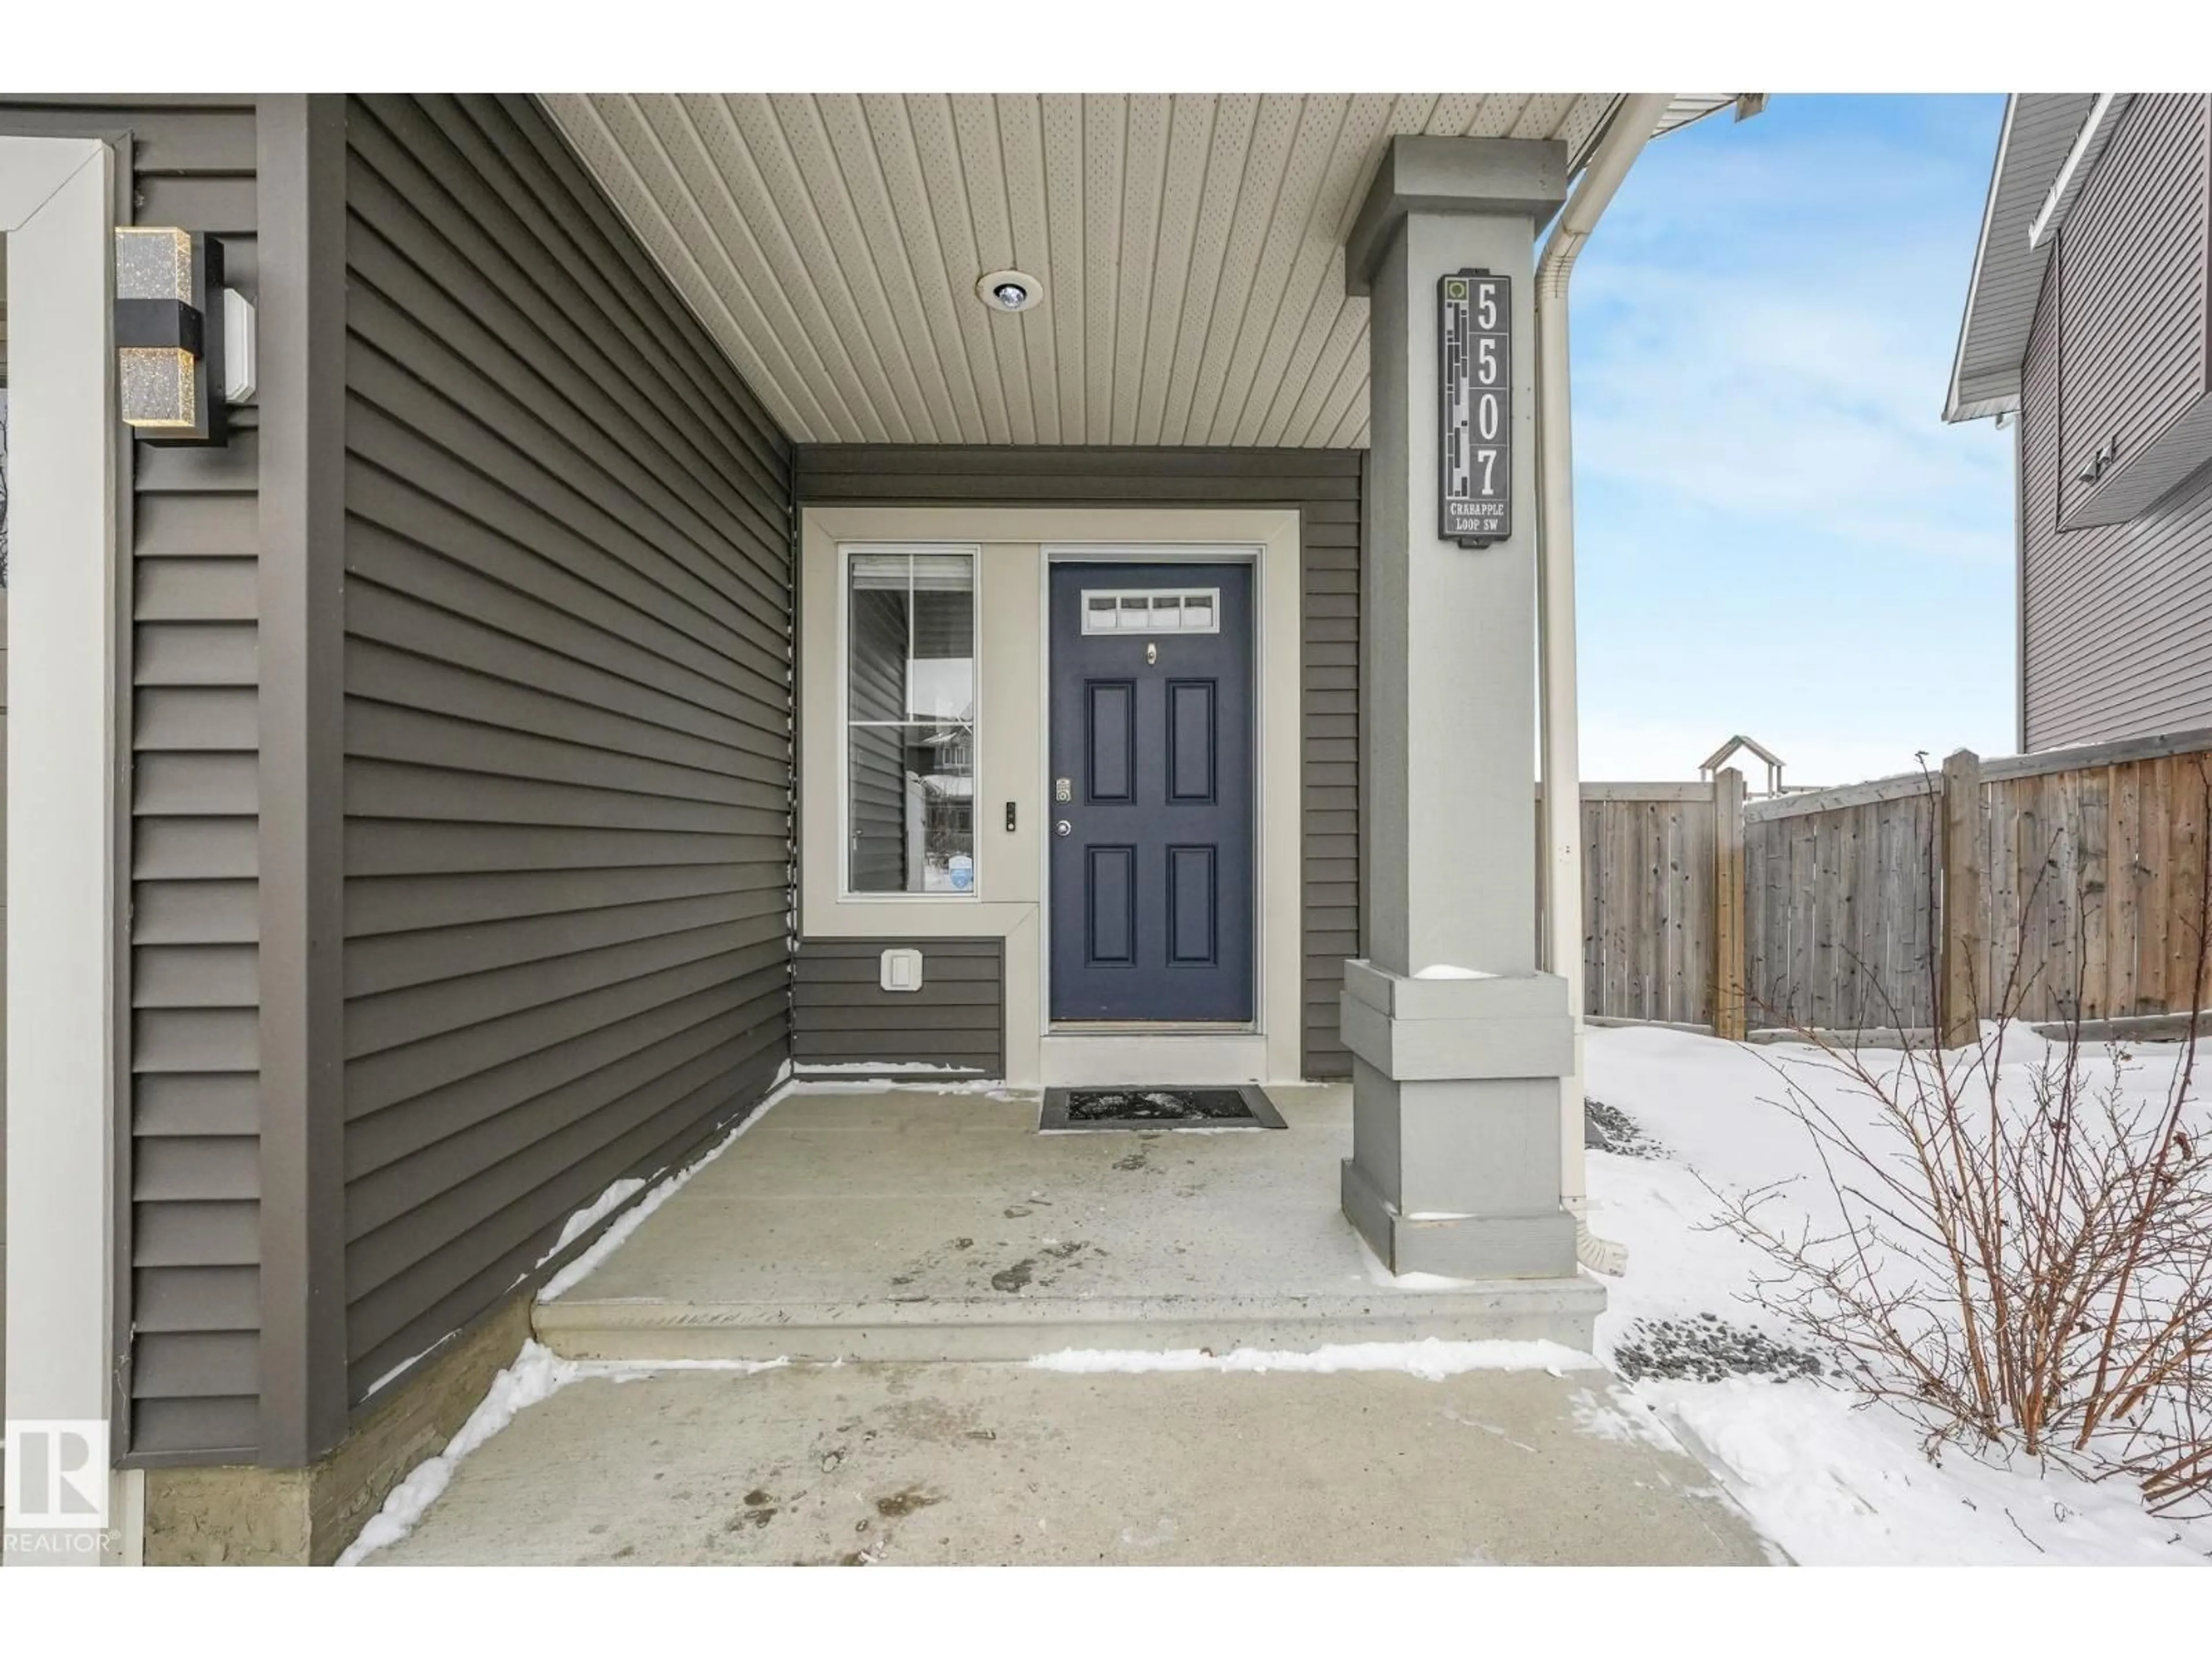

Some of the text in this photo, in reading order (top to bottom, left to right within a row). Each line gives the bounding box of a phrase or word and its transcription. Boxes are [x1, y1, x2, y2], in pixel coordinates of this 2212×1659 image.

[1478, 284, 1498, 495] 5507
[1451, 503, 1503, 515] CRABAPPLE
[1456, 518, 1498, 531] LOOP SW
